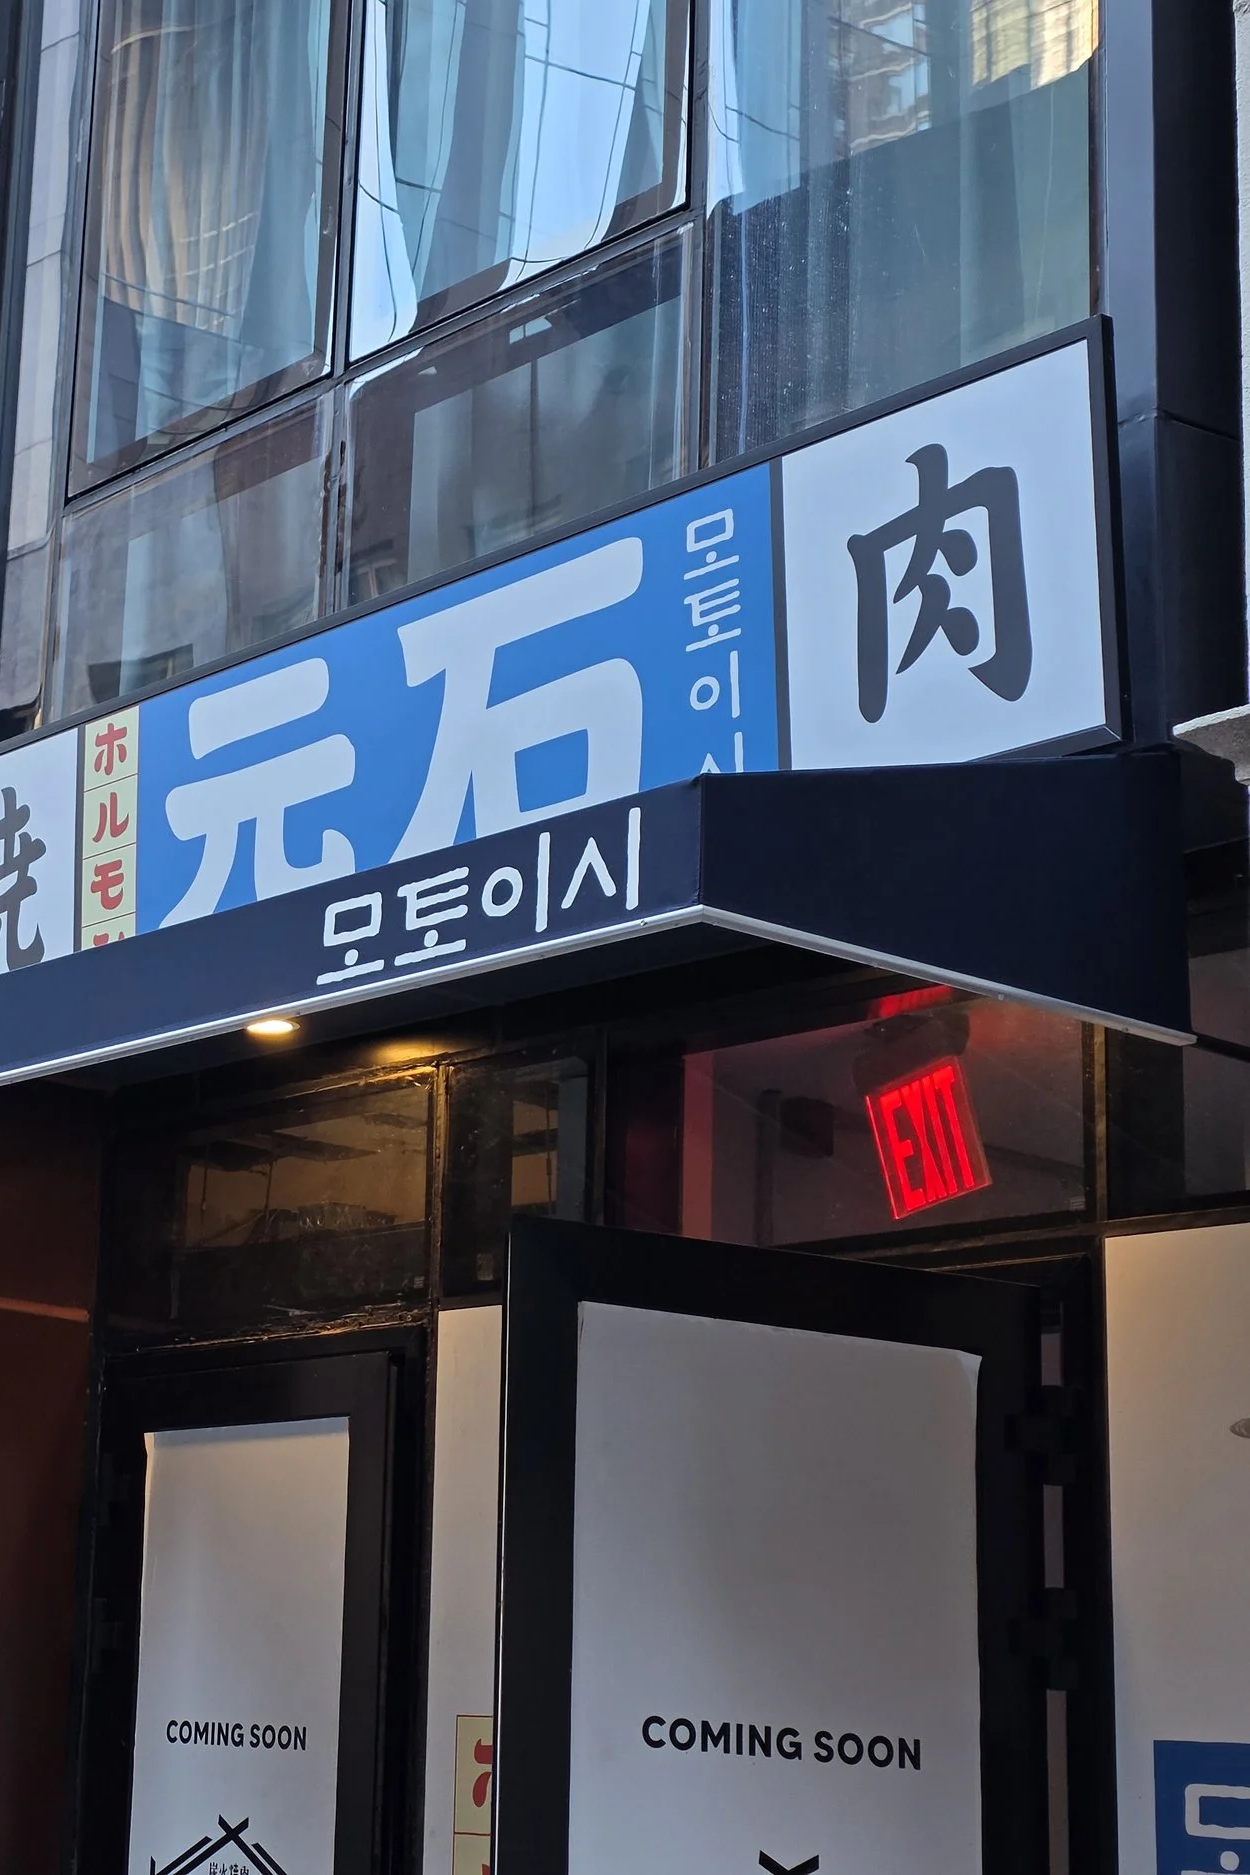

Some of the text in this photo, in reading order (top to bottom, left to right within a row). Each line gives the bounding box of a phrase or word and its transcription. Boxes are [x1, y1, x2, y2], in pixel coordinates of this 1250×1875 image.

[847, 443, 1033, 724] 肉
[316, 807, 641, 986] 모토이시
[879, 1065, 975, 1211] EXIT
[166, 1720, 307, 1751] COMING SOON
[642, 1715, 921, 1770] COMING SOON
